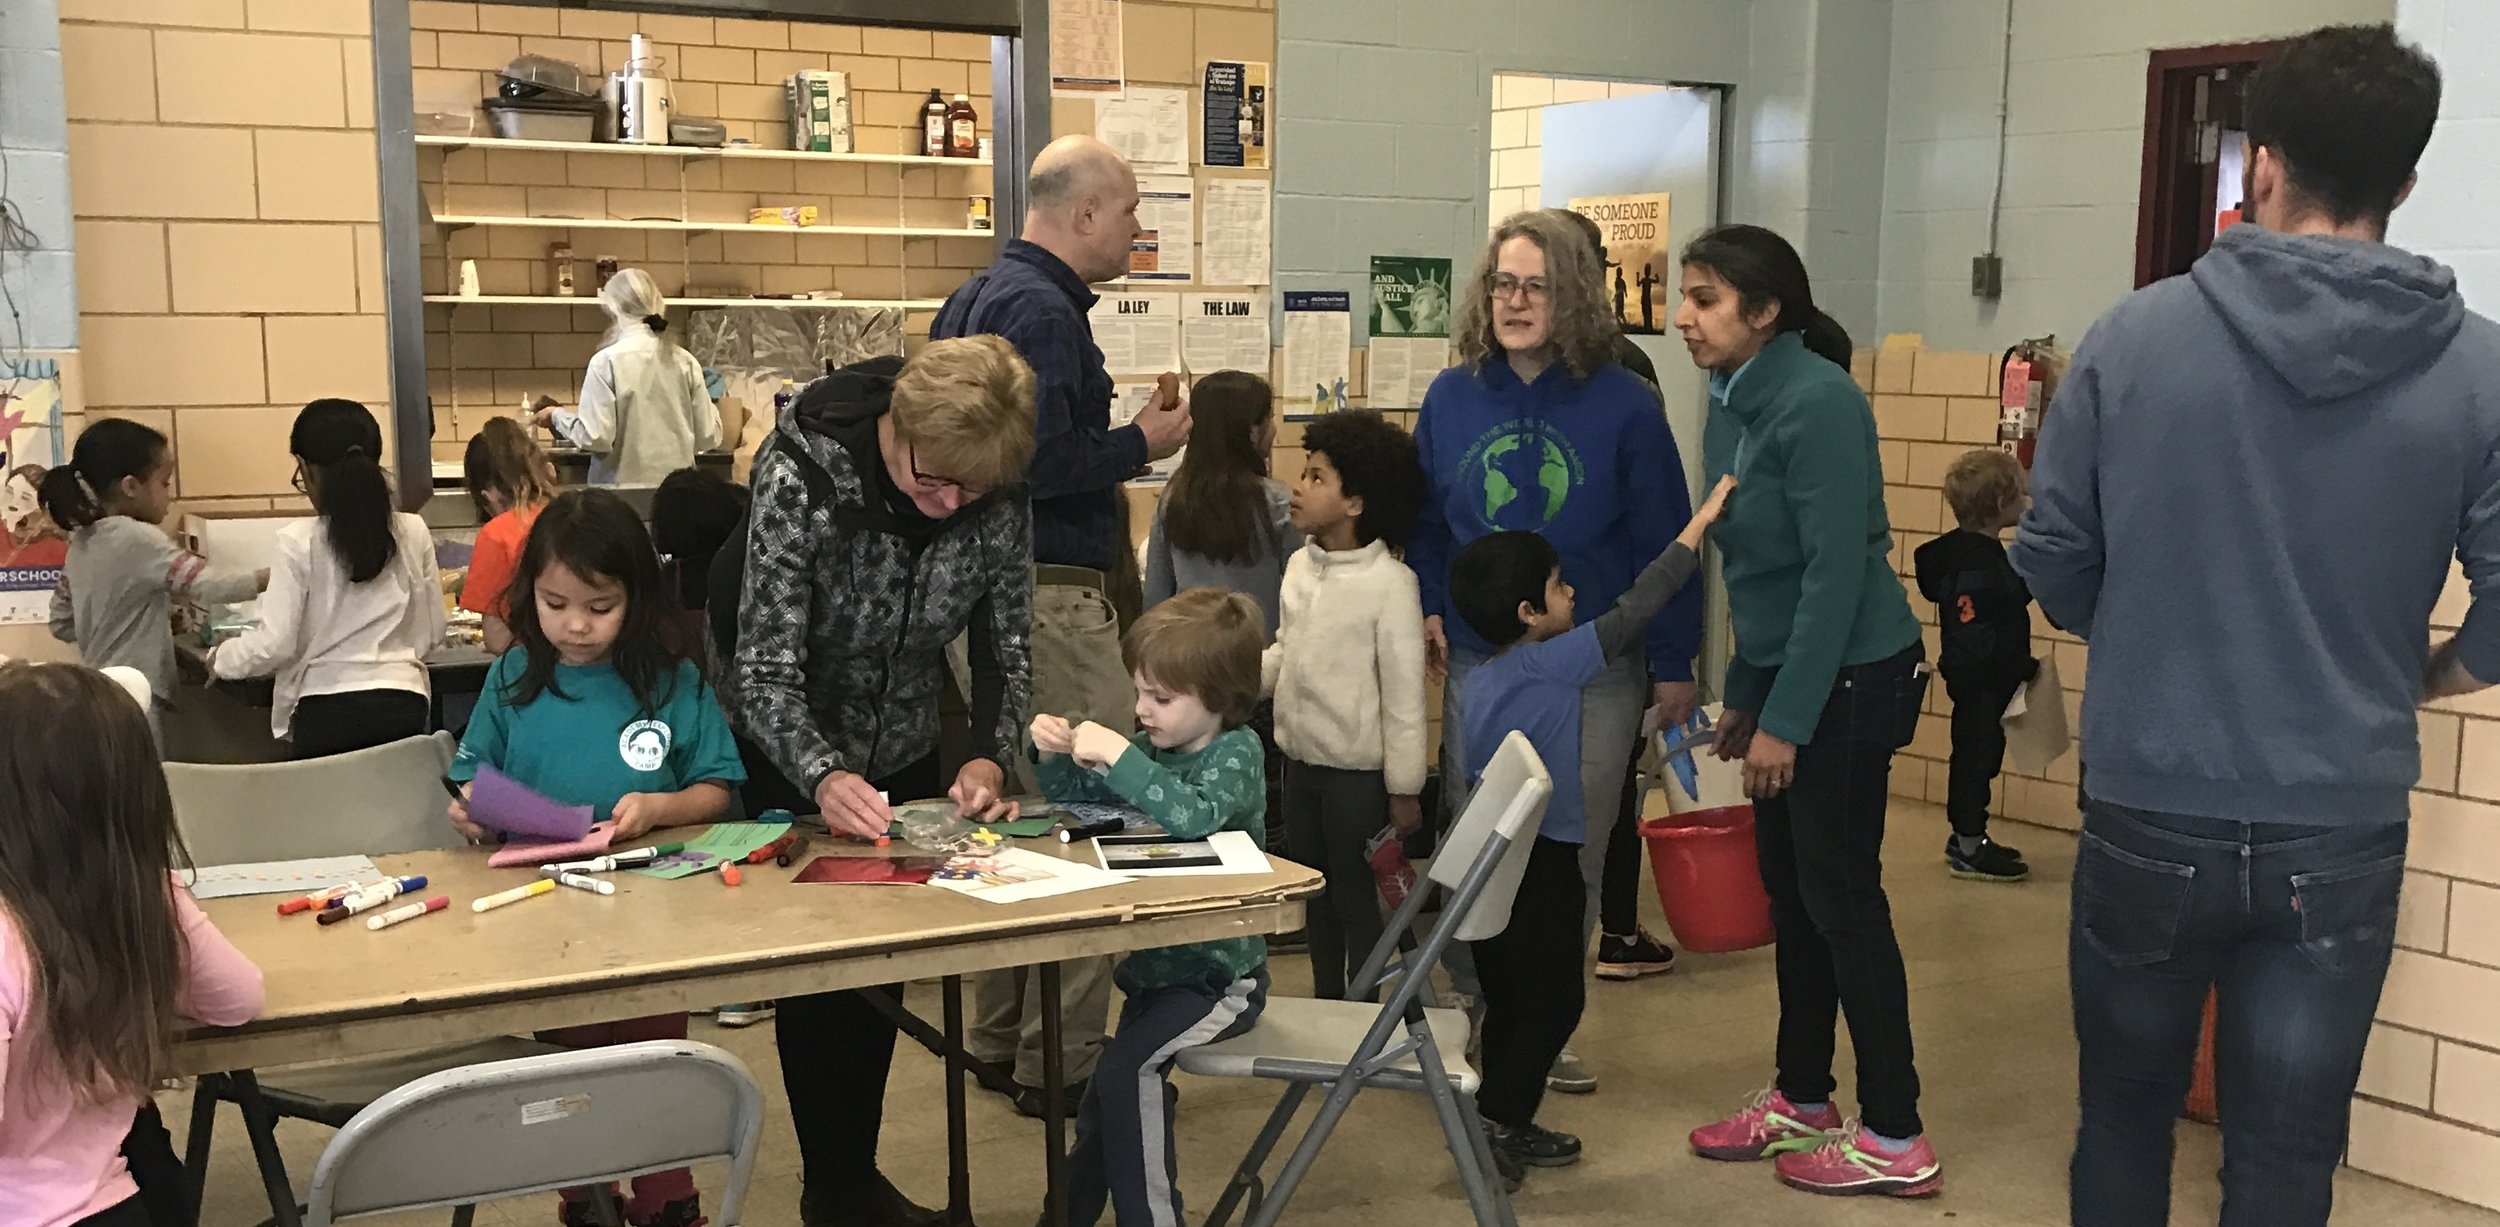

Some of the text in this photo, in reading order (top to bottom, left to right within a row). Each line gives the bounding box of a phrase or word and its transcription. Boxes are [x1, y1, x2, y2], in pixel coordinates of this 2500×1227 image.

[1594, 202, 1659, 221] SOMEONE
[1611, 223, 1656, 241] PROUD
[1374, 275, 1395, 283] AND
[1374, 283, 1415, 293] JUSTICE
[1384, 293, 1403, 301] ALL
[1118, 300, 1149, 314] LA LEY
[1203, 301, 1250, 316] THE LAW
[1957, 595, 1975, 622] 3
[635, 761, 657, 769] CAMP
